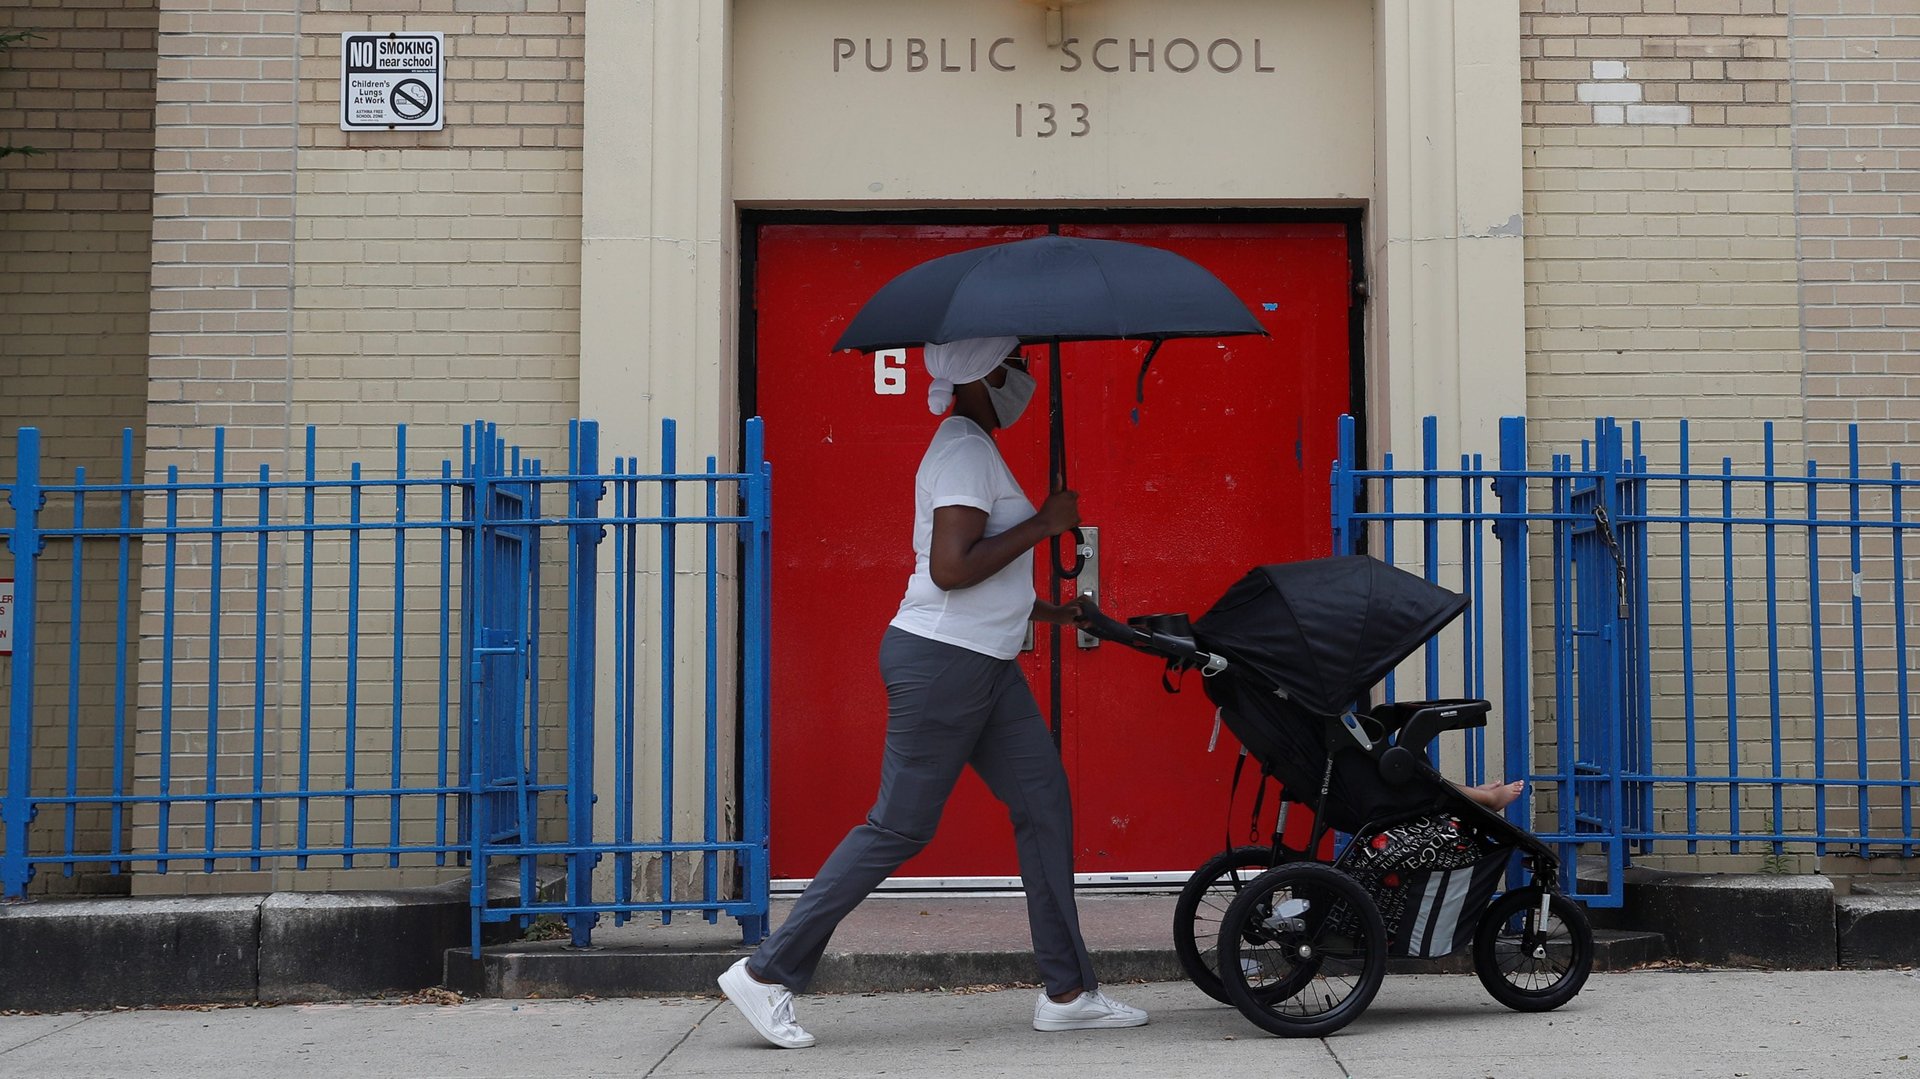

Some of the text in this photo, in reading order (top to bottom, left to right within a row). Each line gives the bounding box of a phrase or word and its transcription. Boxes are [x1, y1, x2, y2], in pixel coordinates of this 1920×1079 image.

[350, 42, 433, 67] NO SMOKING
[379, 56, 433, 67] near school
[832, 37, 1276, 73] PUBLIC SCHOOL
[352, 80, 390, 88] Children's
[359, 88, 383, 97] Lungs
[1015, 102, 1091, 138] 133
[874, 347, 907, 395] 6
